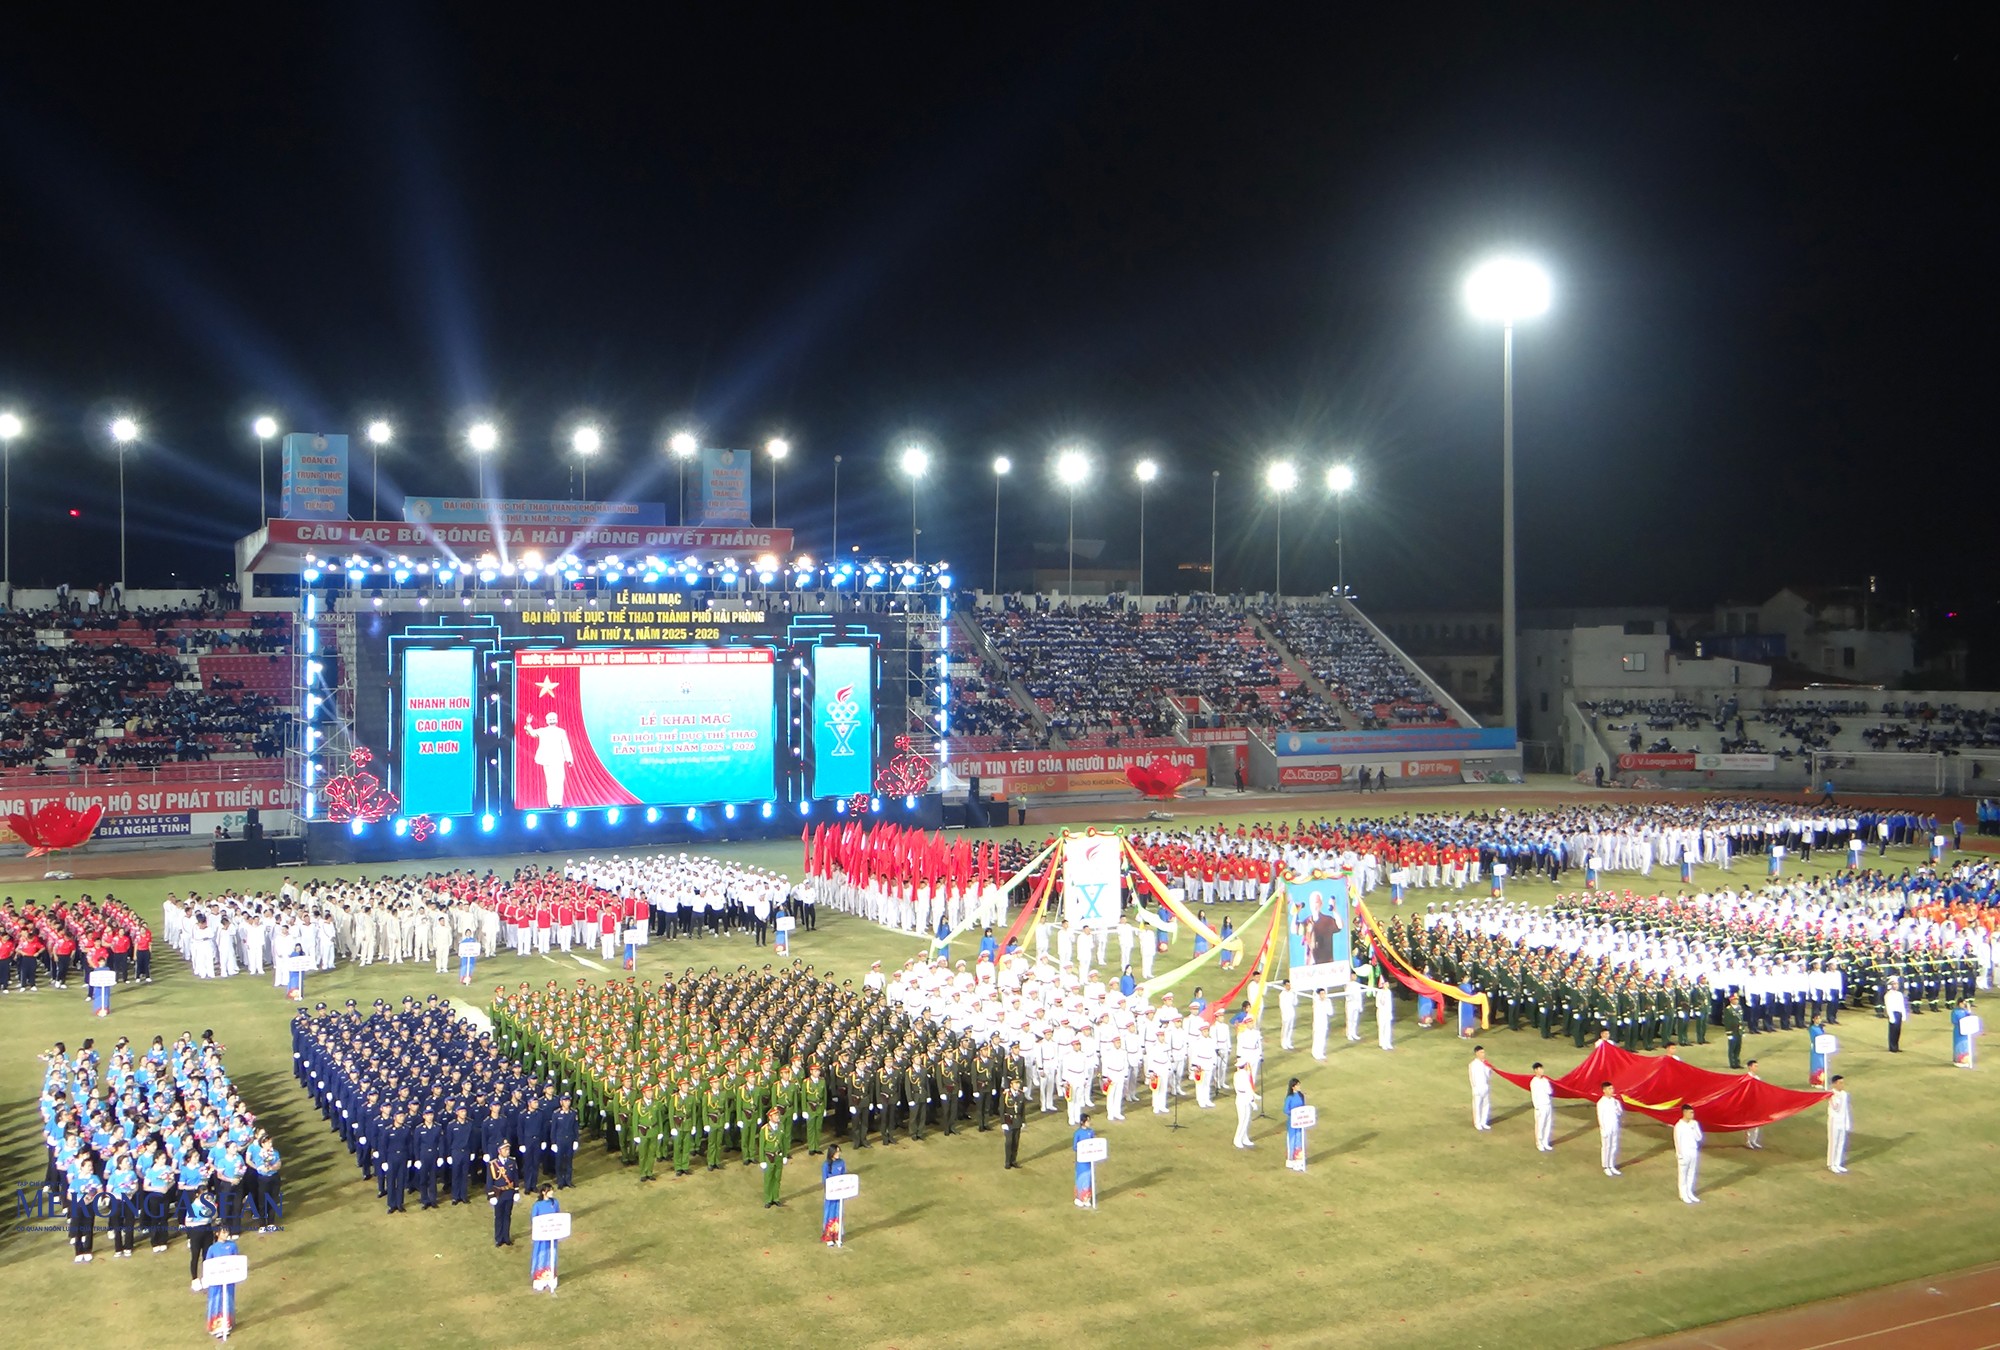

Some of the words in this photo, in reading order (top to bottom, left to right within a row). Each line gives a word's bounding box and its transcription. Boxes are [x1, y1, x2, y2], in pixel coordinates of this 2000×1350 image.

[297, 524, 342, 541] CÂU
[349, 528, 390, 544] LẠC
[397, 525, 426, 544] BỘ
[433, 525, 491, 543] BÓNG
[498, 527, 525, 543] ĐÁ
[531, 526, 566, 544] HẢI
[574, 527, 639, 545] PHÒNG
[645, 528, 705, 546] QUYẾT
[710, 529, 771, 547] THẮNG
[616, 589, 630, 605] LỄ
[631, 592, 656, 605] KHAI
[658, 593, 682, 607] MẠC
[522, 611, 541, 625] ĐẠI
[543, 608, 561, 625] HỘI
[562, 606, 583, 623] THỂ
[584, 611, 605, 625] DỤC
[607, 606, 627, 623] THỂ
[628, 611, 654, 623] THAO
[656, 609, 690, 623] THÀNH
[691, 607, 712, 623] PHỐ
[713, 608, 730, 623] HẢI
[731, 609, 765, 623] PHÒNG
[576, 625, 598, 641] LẦN
[600, 626, 622, 641] THỨ
[623, 628, 634, 642] X,
[635, 626, 660, 640] NĂM
[661, 628, 687, 640] 2025
[694, 628, 720, 640] 2026
[410, 698, 446, 709] NHANH
[449, 697, 470, 709] HƠN
[641, 711, 657, 726] LỄ
[662, 715, 697, 725] KHAI
[417, 720, 438, 731] CAO
[441, 719, 462, 731] HƠN
[729, 731, 758, 739] THAO
[421, 743, 434, 753] XA
[437, 741, 459, 753] HƠN
[664, 745, 672, 753] X
[675, 743, 699, 753] NĂM
[701, 744, 724, 752] 2025
[733, 743, 756, 751] 2026
[985, 761, 1006, 775] TIN
[1010, 757, 1033, 774] YÊU
[1037, 754, 1063, 773] CỦA
[1066, 754, 1104, 772] NGƯỜI
[1419, 764, 1436, 774] FPT
[1436, 763, 1453, 774] Play
[1297, 769, 1338, 782] Kappa
[1008, 782, 1046, 793] LPBank
[108, 791, 132, 815] HỘ
[137, 792, 163, 814] SỰ
[166, 788, 210, 809] PHÁT
[214, 783, 264, 807] TRIỂN
[119, 816, 180, 825] SAVABECO
[100, 826, 121, 836] BIA
